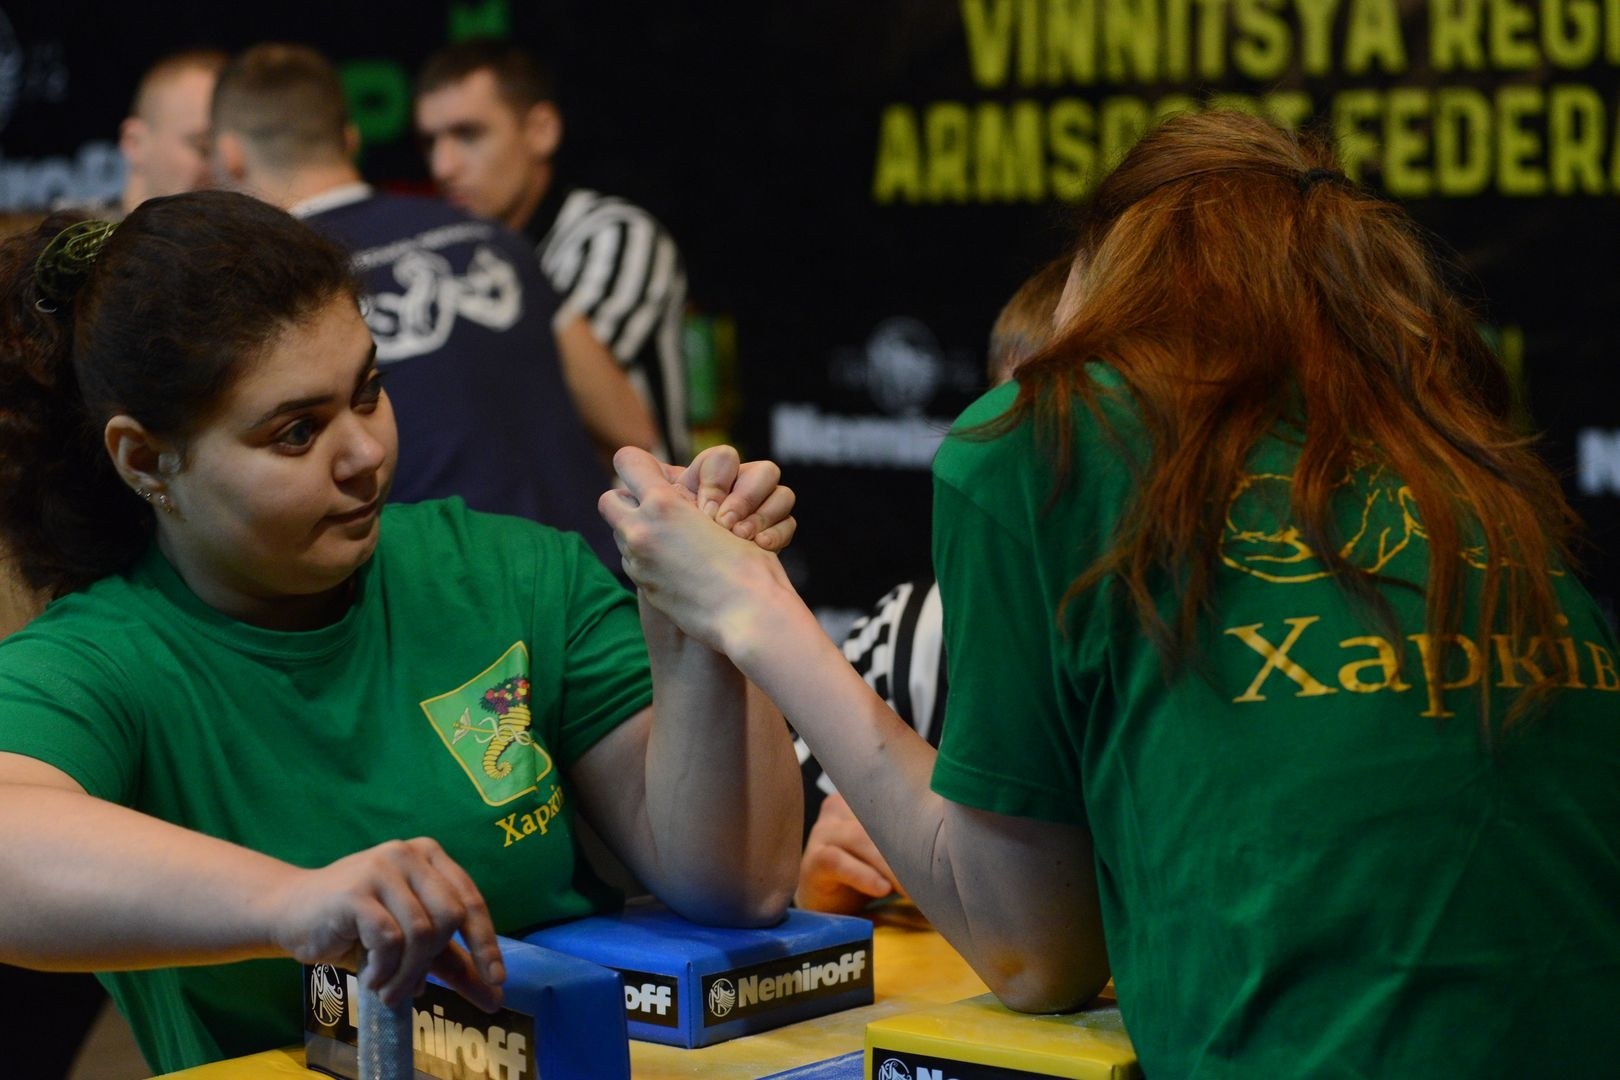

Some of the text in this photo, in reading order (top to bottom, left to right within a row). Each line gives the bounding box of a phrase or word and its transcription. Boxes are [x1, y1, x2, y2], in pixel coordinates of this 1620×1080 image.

[963, 0, 1403, 85] VINNITSYA
[873, 84, 1620, 201] ARMSP FEDER
[738, 950, 865, 1008] Nemiroff
